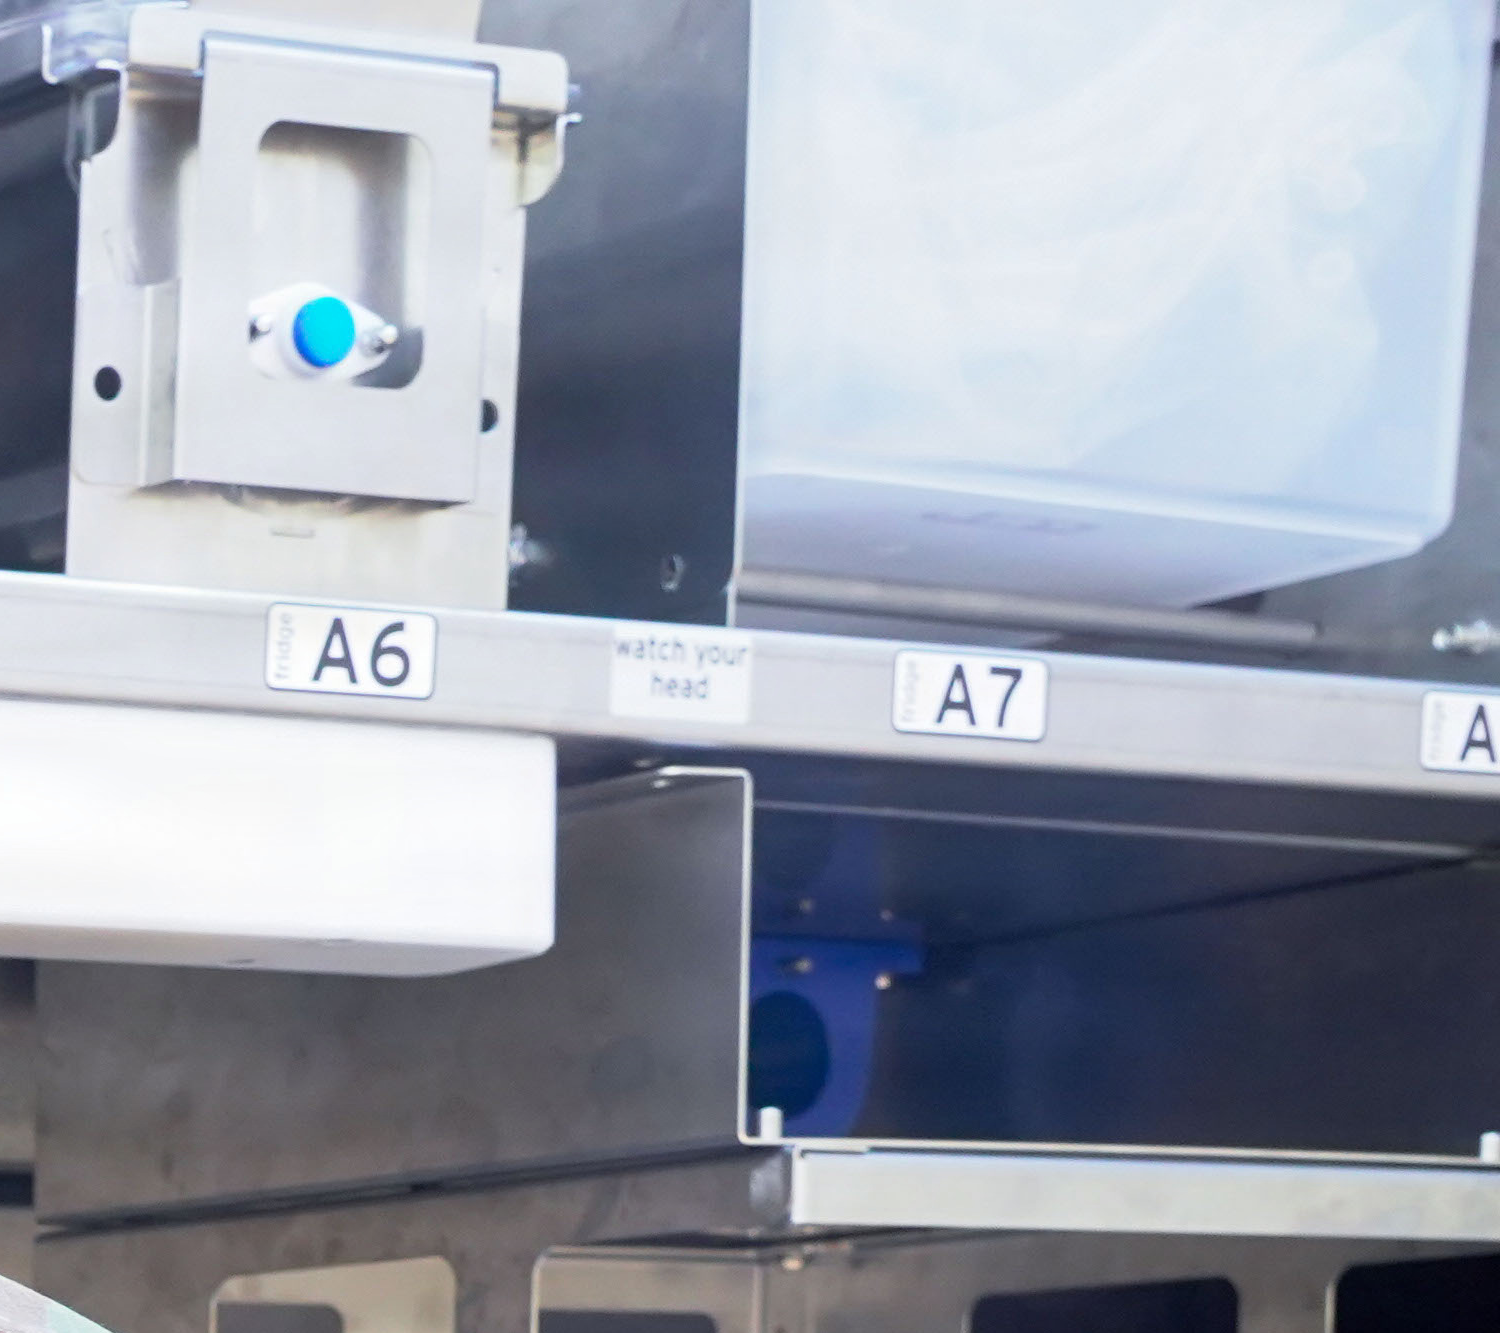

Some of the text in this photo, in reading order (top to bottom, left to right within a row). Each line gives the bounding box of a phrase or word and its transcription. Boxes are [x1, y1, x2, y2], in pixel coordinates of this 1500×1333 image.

[311, 616, 411, 687] A6
[615, 634, 748, 671] watch your
[650, 671, 710, 699] head
[935, 663, 1023, 728] A7
